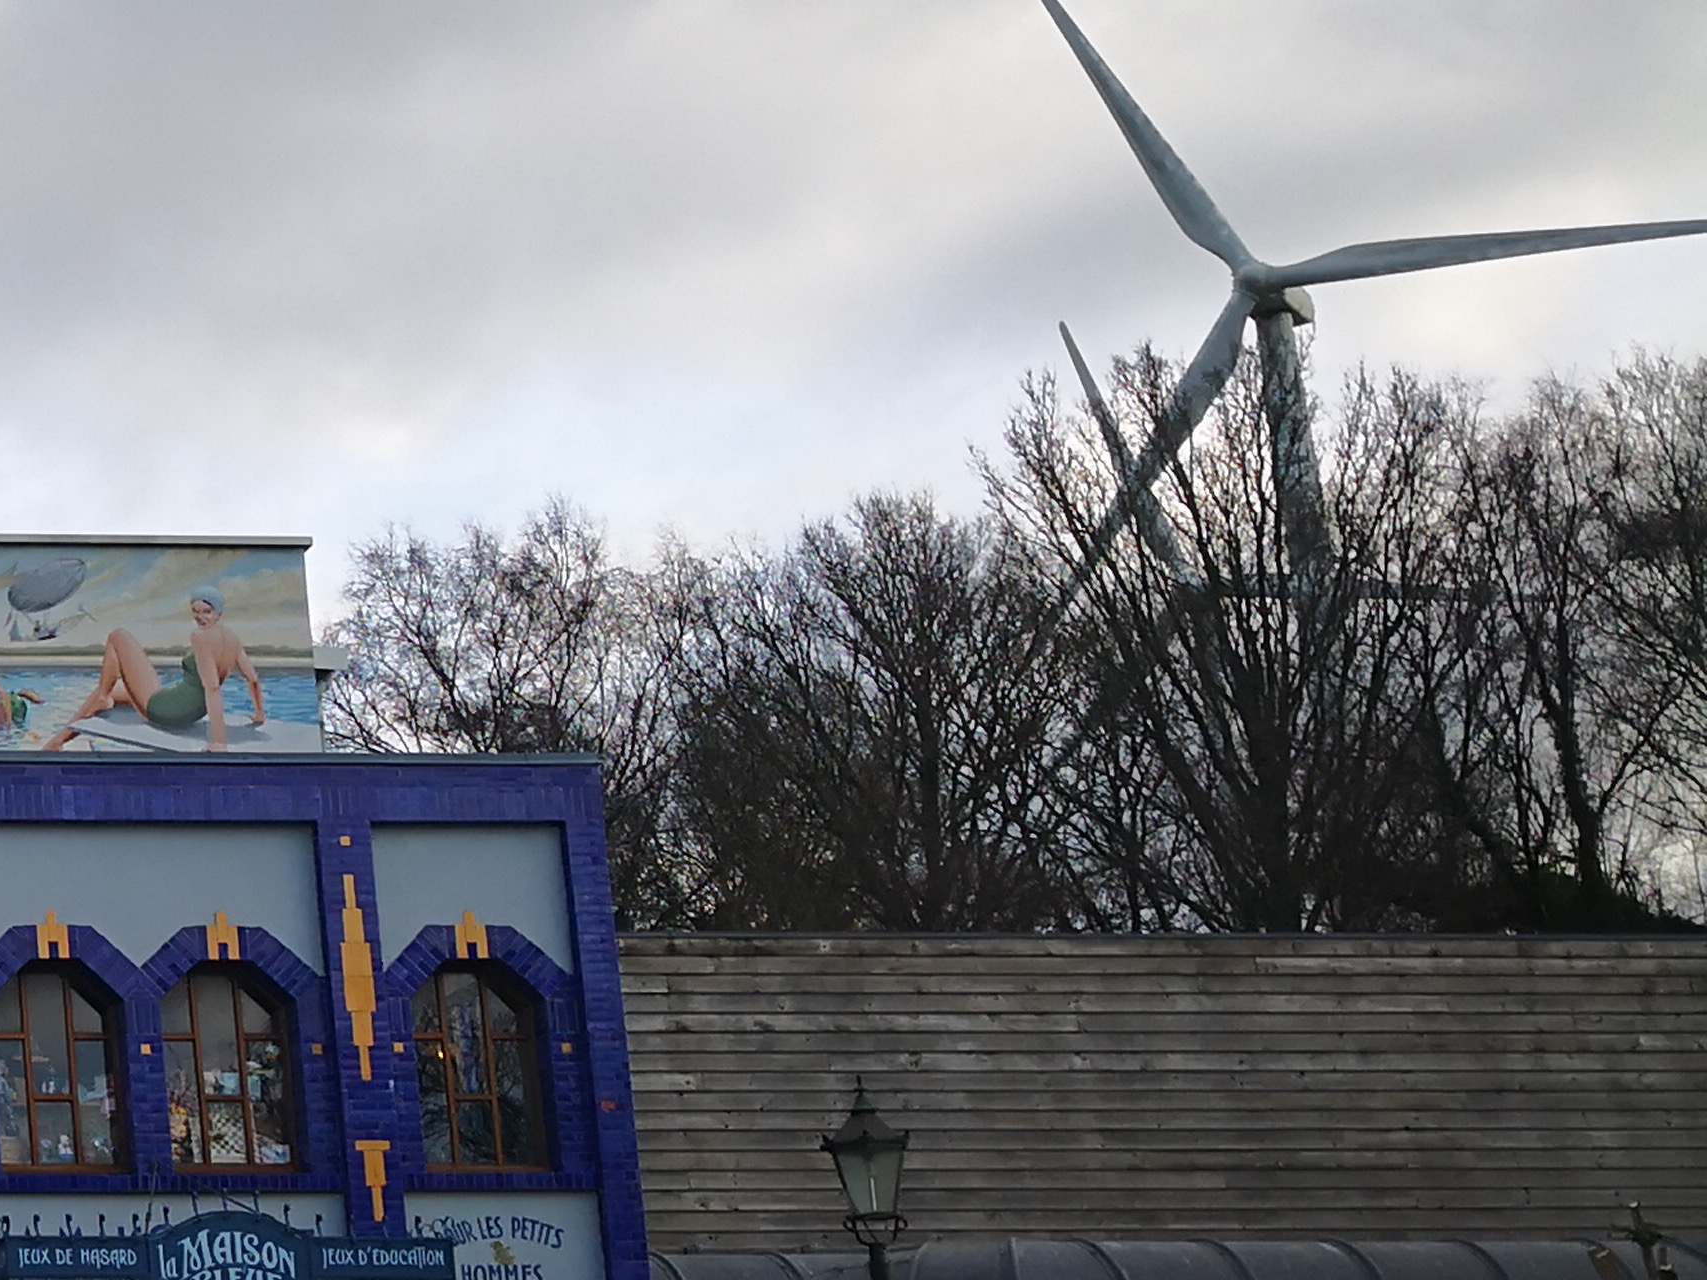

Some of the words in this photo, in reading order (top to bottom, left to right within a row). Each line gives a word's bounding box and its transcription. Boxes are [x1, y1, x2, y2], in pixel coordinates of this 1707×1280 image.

[476, 1216, 504, 1240] LES
[511, 1216, 565, 1250] PETITS
[18, 1247, 52, 1269] JEUX
[55, 1247, 75, 1266] DE
[80, 1247, 138, 1270] HASARD
[321, 1247, 356, 1270] JEUX
